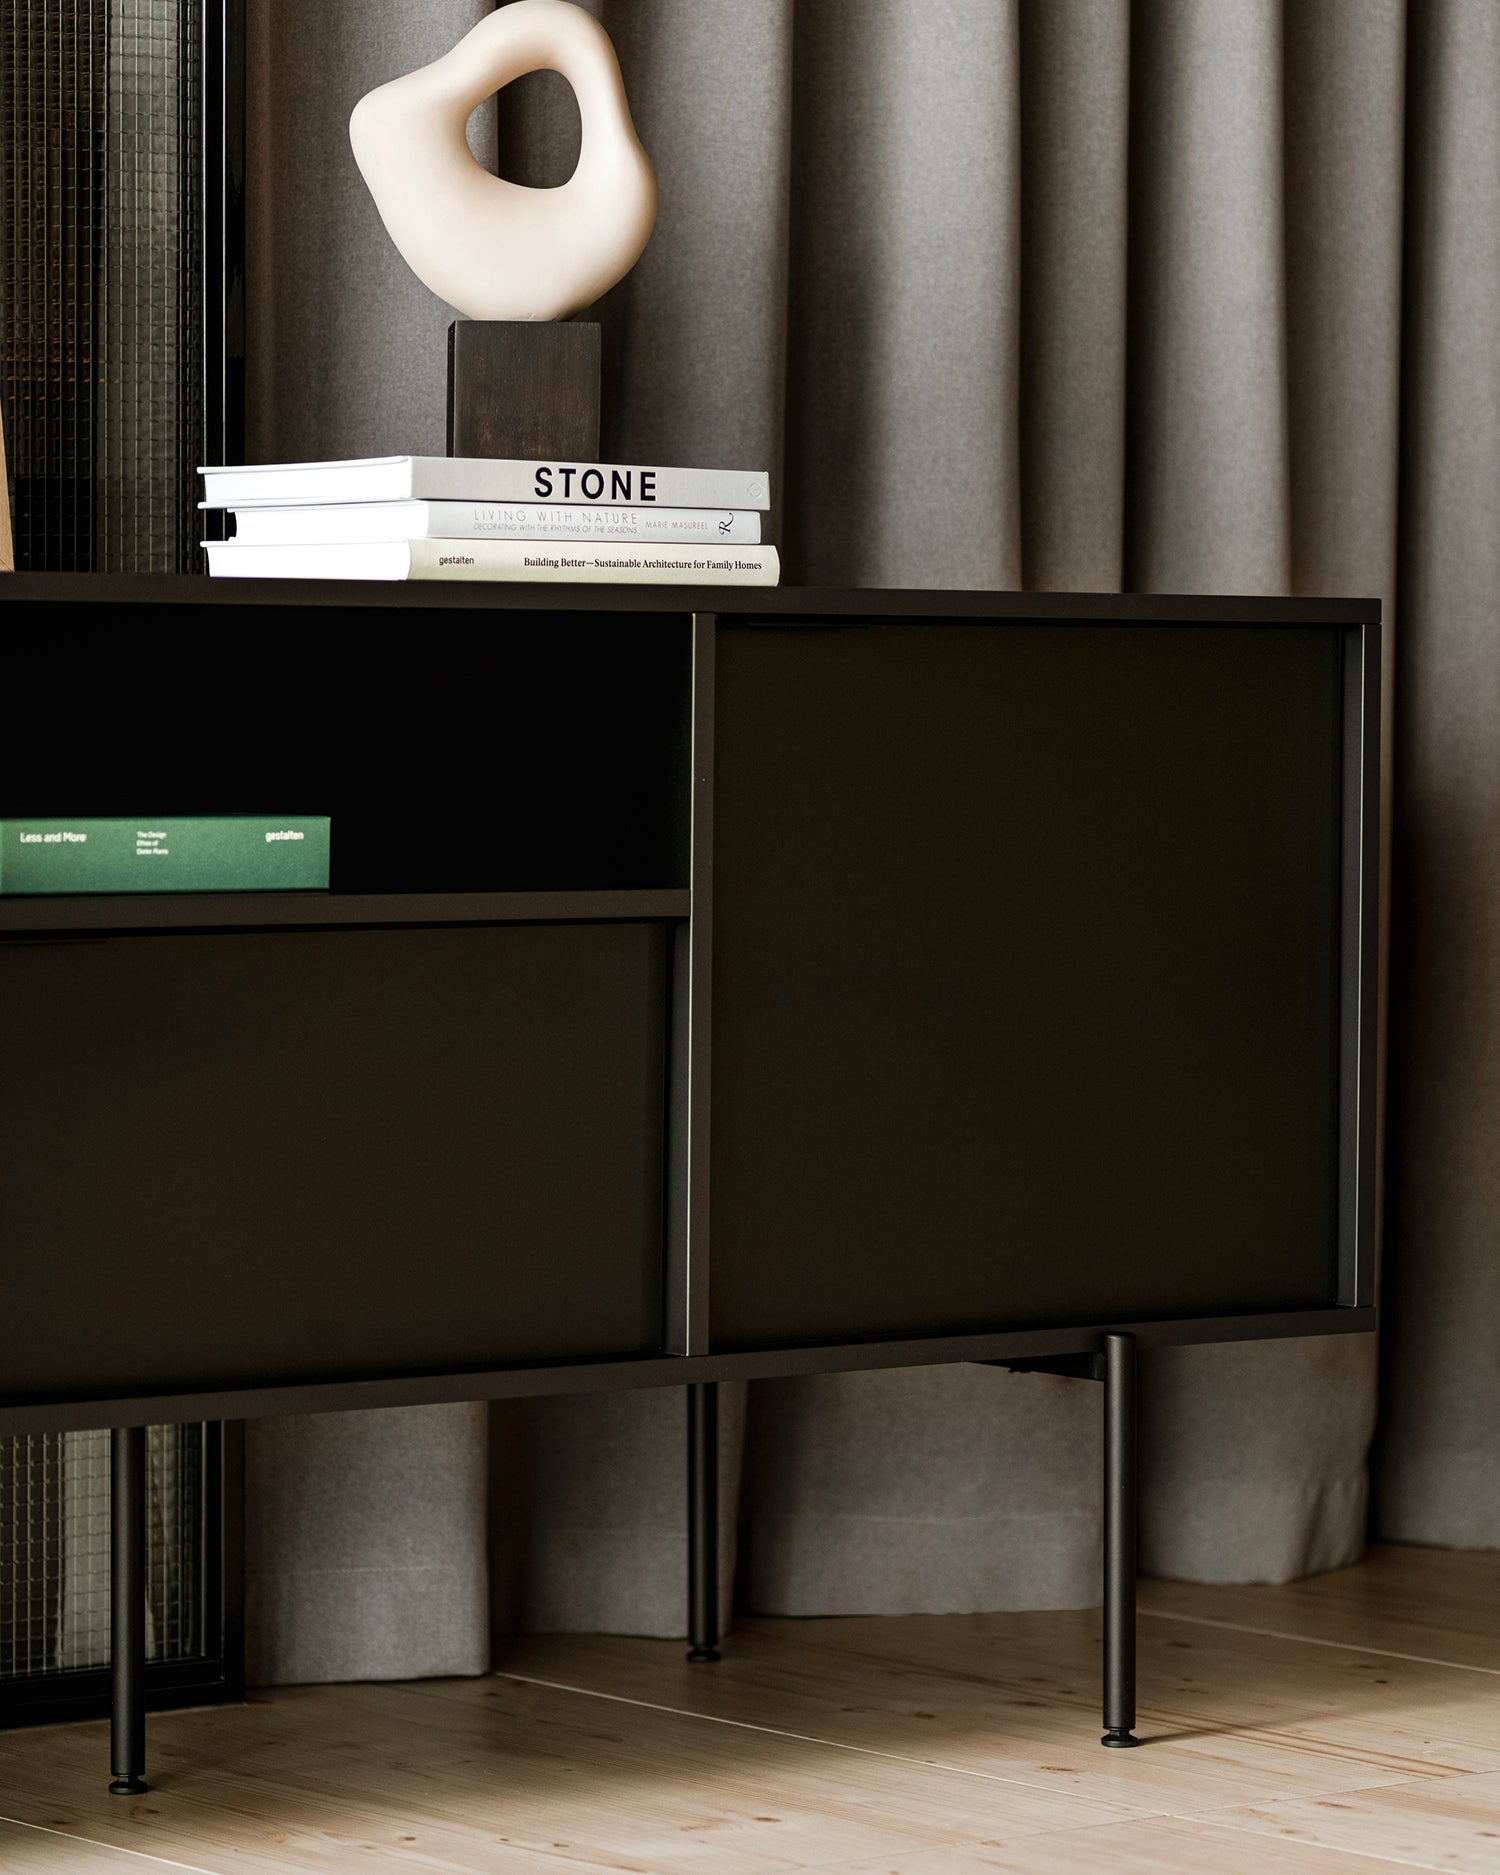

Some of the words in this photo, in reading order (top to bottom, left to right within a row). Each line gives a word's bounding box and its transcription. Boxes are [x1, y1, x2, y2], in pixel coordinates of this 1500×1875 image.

[534, 467, 656, 501] STONE
[474, 509, 526, 522] LIVING
[537, 511, 573, 523] WITH
[582, 512, 638, 525] NATURE
[474, 522, 517, 531] DECORATING
[519, 524, 535, 532] WITH
[537, 524, 548, 532] THE
[550, 524, 581, 533] RHYTHMS
[582, 525, 592, 533] OF
[594, 525, 605, 534] THE
[607, 526, 638, 534] SEASONS
[645, 521, 668, 529] MARIE
[672, 521, 708, 530] MASUREEL
[439, 554, 474, 566] gestalten
[524, 557, 559, 569] Building
[642, 560, 692, 569] Architecture
[693, 560, 706, 569] for
[706, 560, 733, 571] Family
[735, 561, 762, 570] Homes
[20, 832, 43, 843] Less
[43, 832, 61, 843] and
[62, 832, 87, 843] More
[137, 831, 147, 839] The
[147, 831, 167, 840] Design
[266, 830, 304, 842] gestalten
